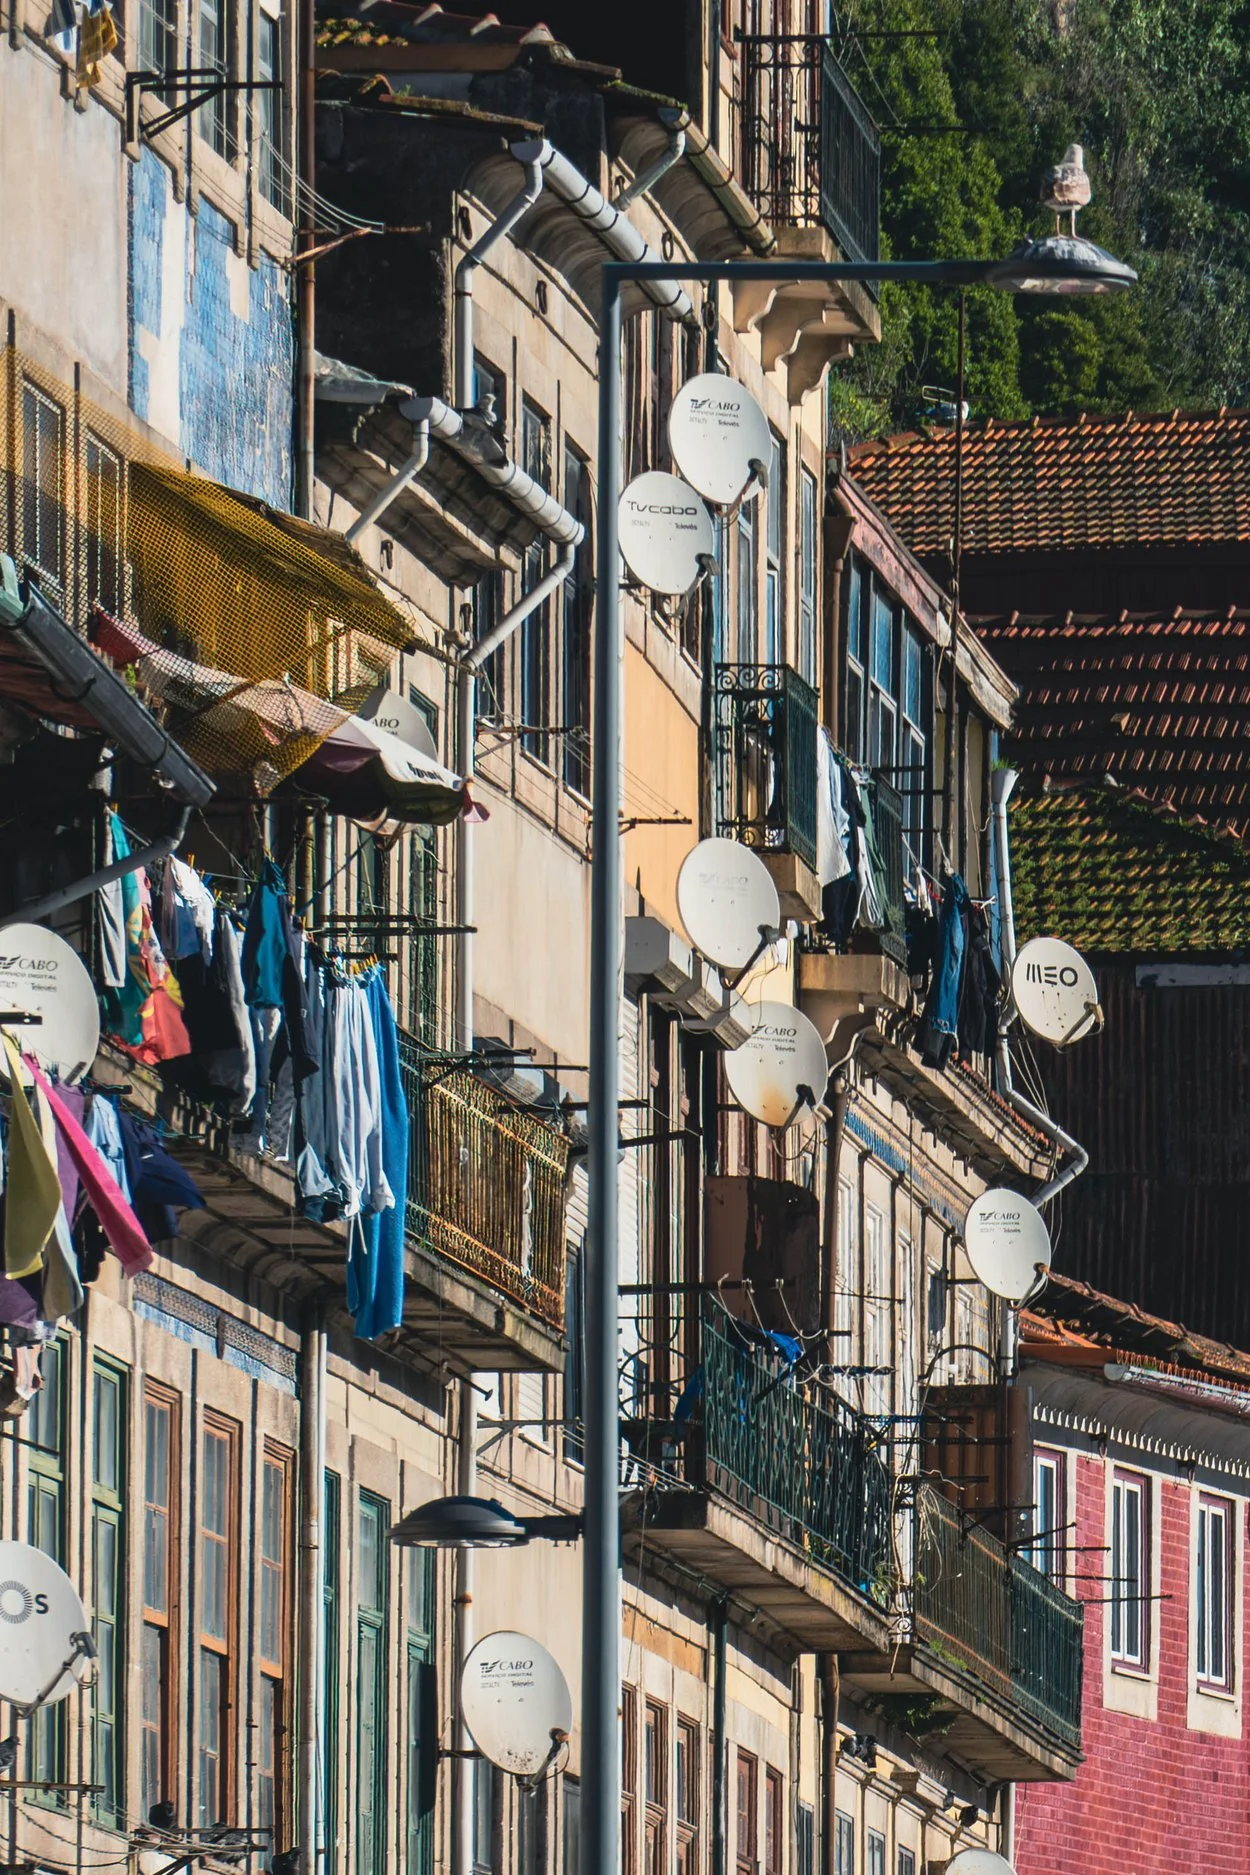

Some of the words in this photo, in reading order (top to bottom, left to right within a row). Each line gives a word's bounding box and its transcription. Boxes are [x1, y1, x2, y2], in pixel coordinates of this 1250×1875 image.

[708, 401, 740, 411] CABO
[19, 958, 58, 972] CABO
[1026, 963, 1078, 987] MEO
[764, 1026, 797, 1037] CABO
[994, 1212, 1020, 1220] CABO
[499, 1660, 533, 1670] CABO
